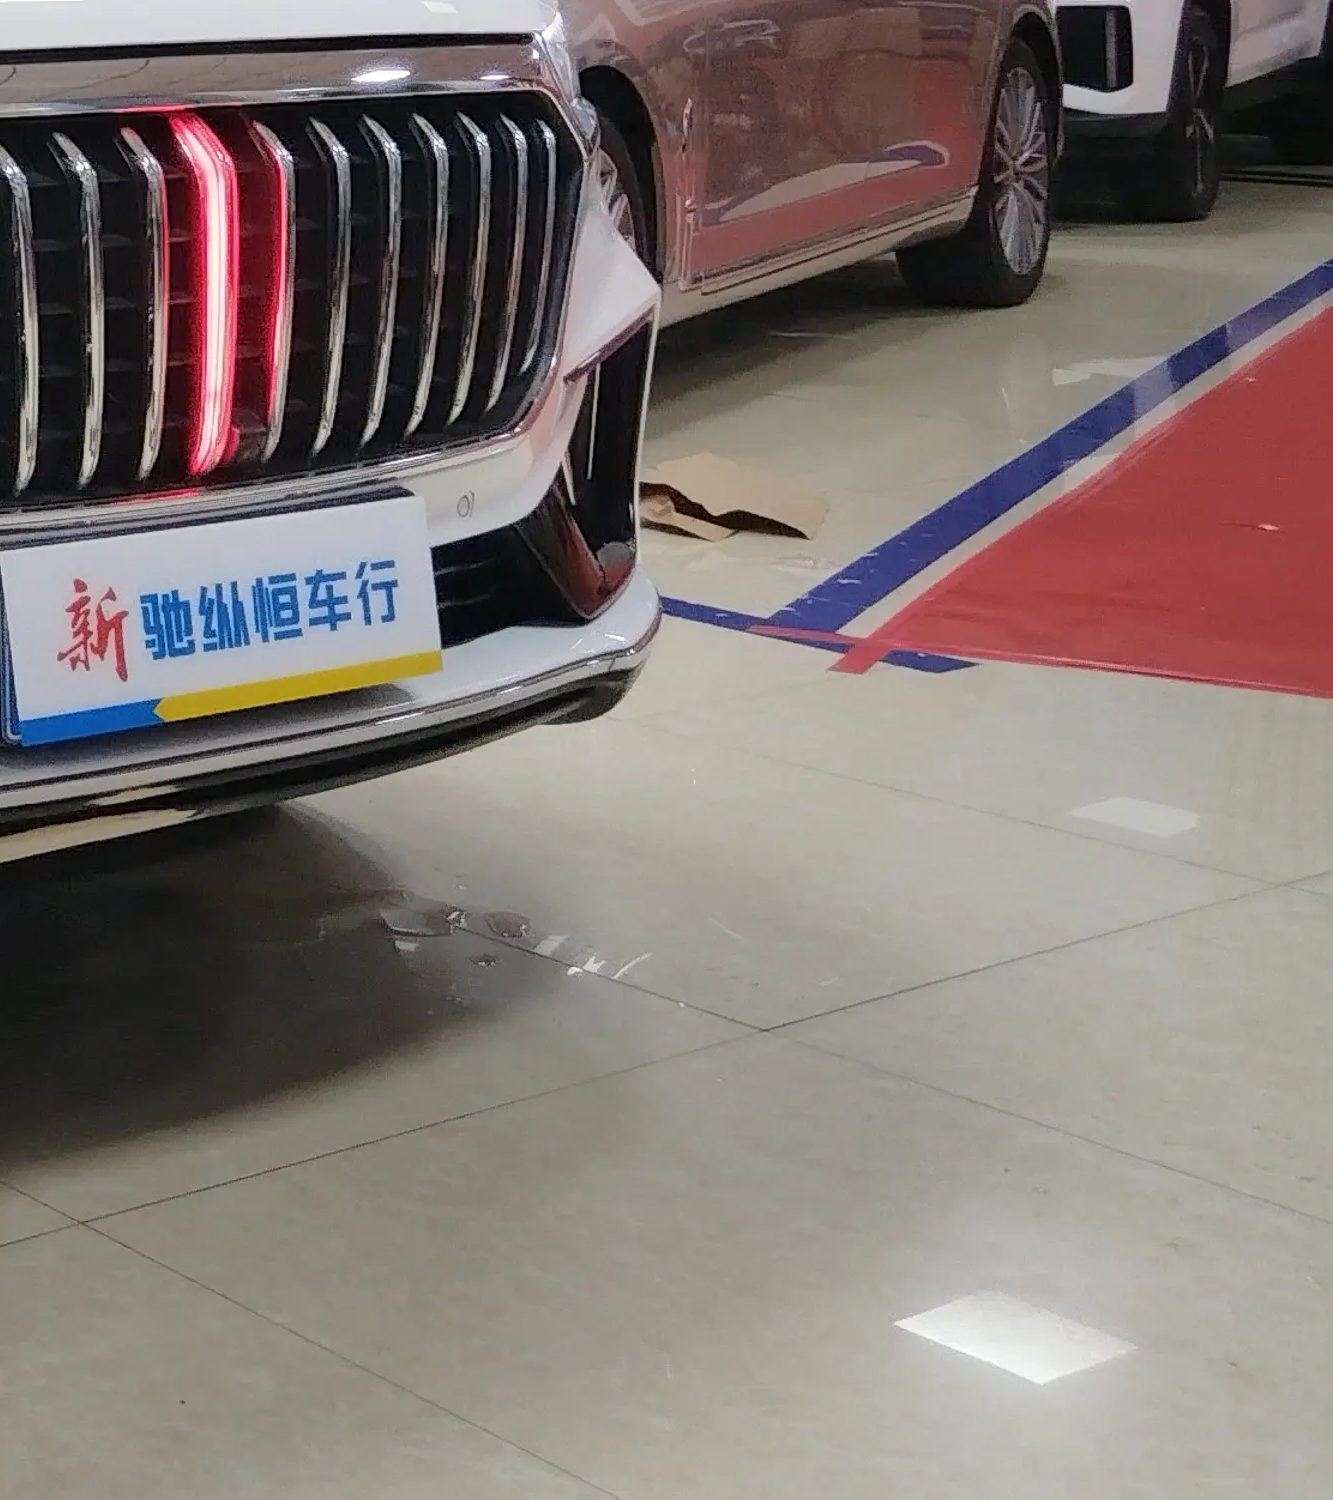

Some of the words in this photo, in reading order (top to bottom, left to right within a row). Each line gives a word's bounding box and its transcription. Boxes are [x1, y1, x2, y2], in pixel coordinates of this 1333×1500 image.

[56, 559, 401, 683] 新驰纵恒车行
